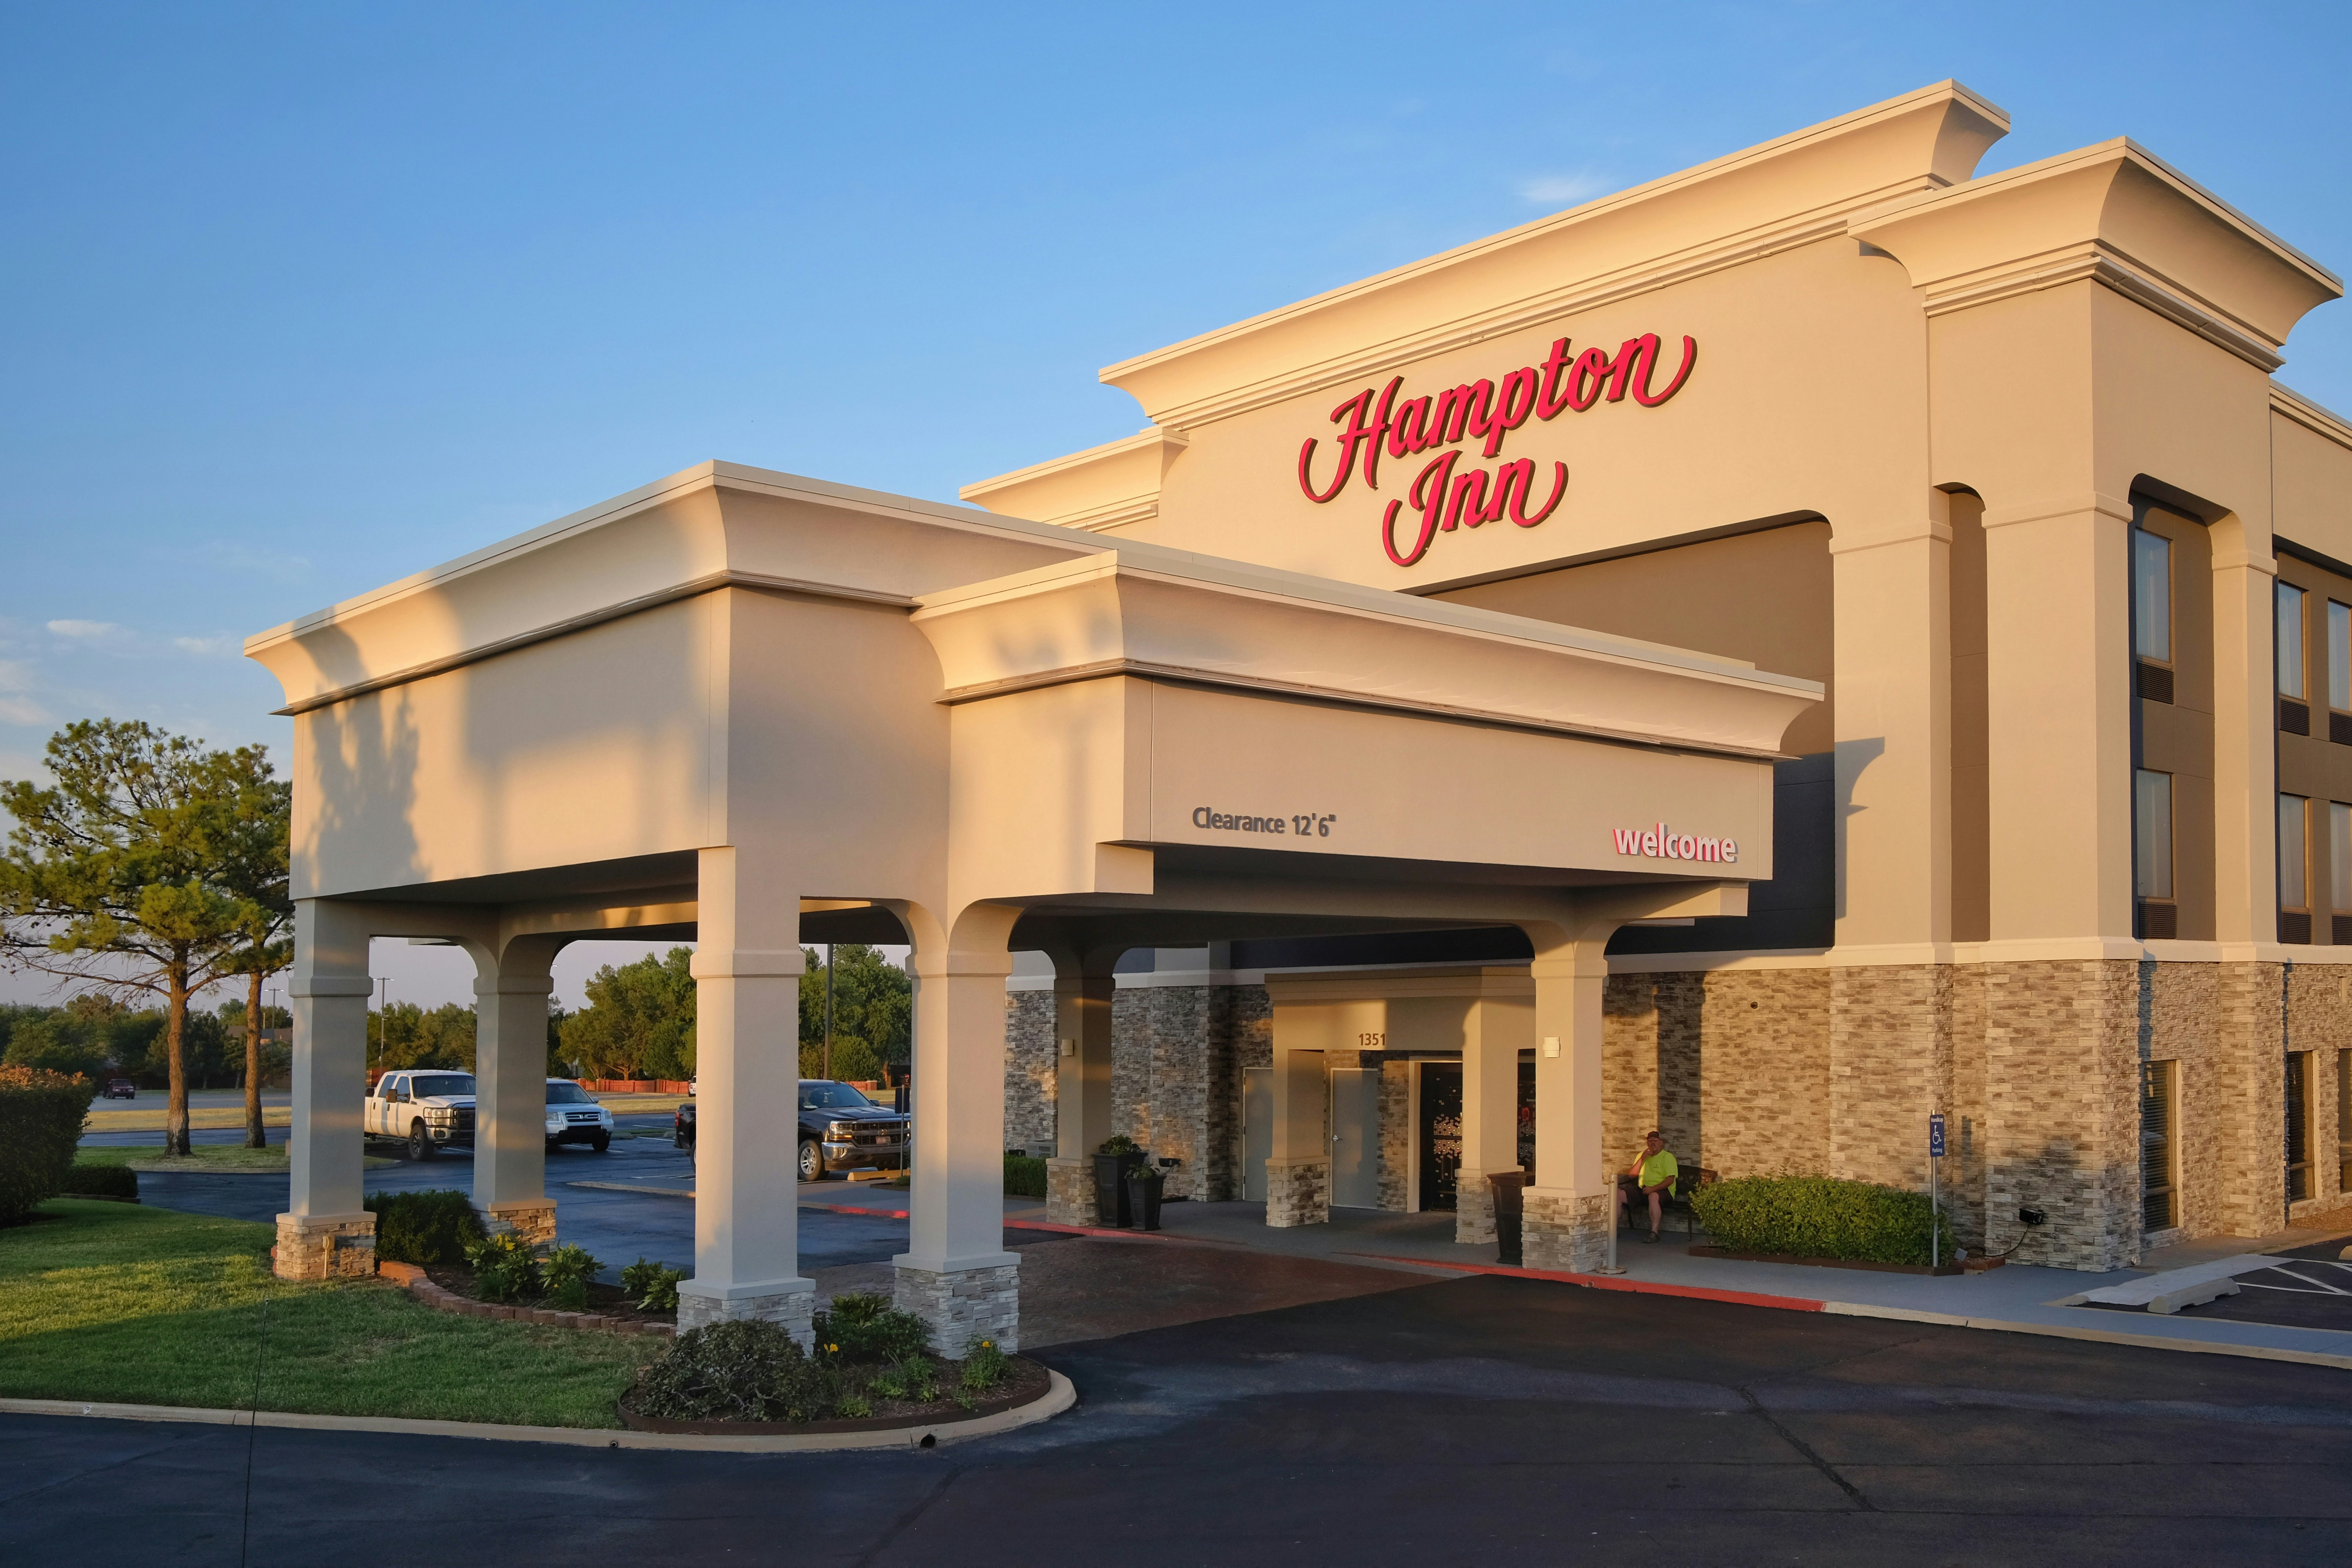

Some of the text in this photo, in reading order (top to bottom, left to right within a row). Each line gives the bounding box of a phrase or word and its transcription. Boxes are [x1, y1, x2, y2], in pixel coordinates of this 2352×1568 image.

[1298, 333, 1697, 503] Hampton
[1382, 450, 1568, 567] Inn
[1192, 807, 1336, 837] Clearance 12'6"
[1613, 823, 1737, 862] welcome
[1358, 1033, 1385, 1046] 1351
